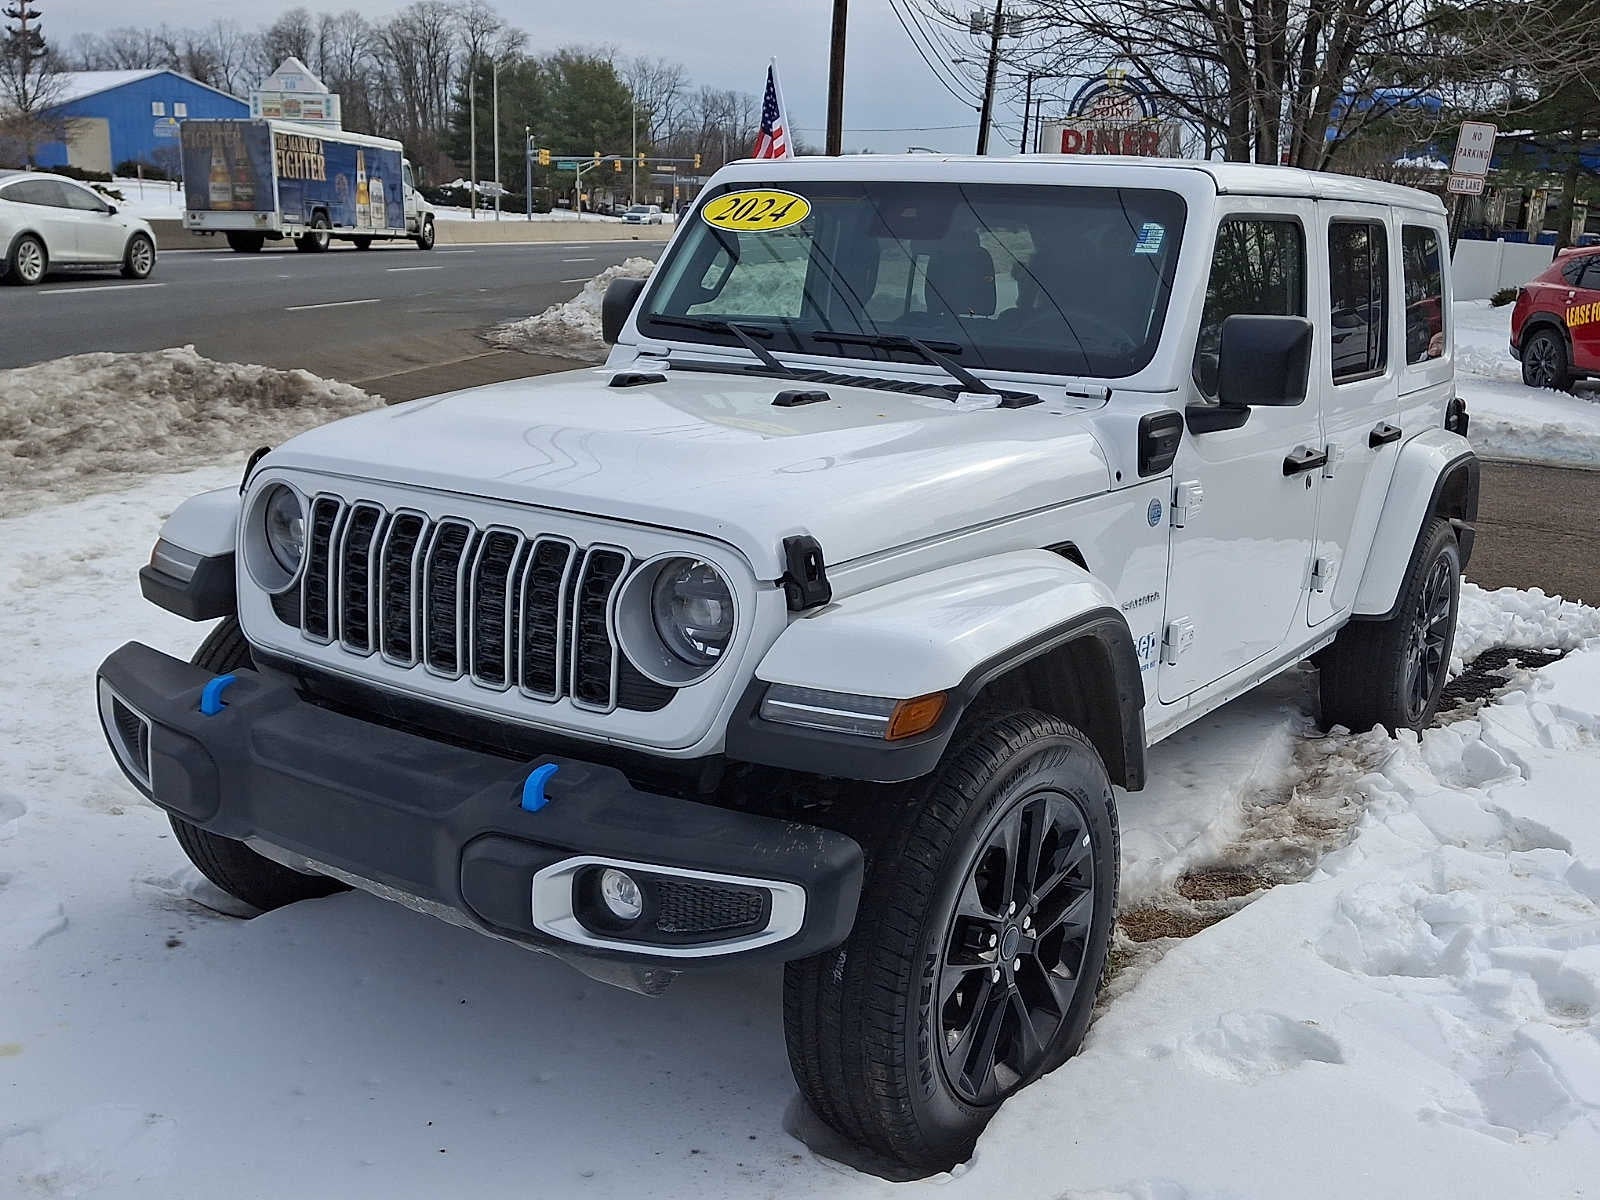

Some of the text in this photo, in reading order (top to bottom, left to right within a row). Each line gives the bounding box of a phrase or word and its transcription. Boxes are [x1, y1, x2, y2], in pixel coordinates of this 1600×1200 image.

[1093, 107, 1133, 117] POINT
[1061, 129, 1160, 154] DINER
[1471, 131, 1483, 142] NO
[1458, 147, 1489, 160] PARKING
[275, 149, 327, 181] FIGHTER
[1450, 179, 1481, 191] FIRE LANE
[713, 198, 798, 223] 2024
[1566, 303, 1591, 328] LEASE
[1121, 592, 1161, 611] SAHARA
[917, 953, 939, 1087] NEXEN
